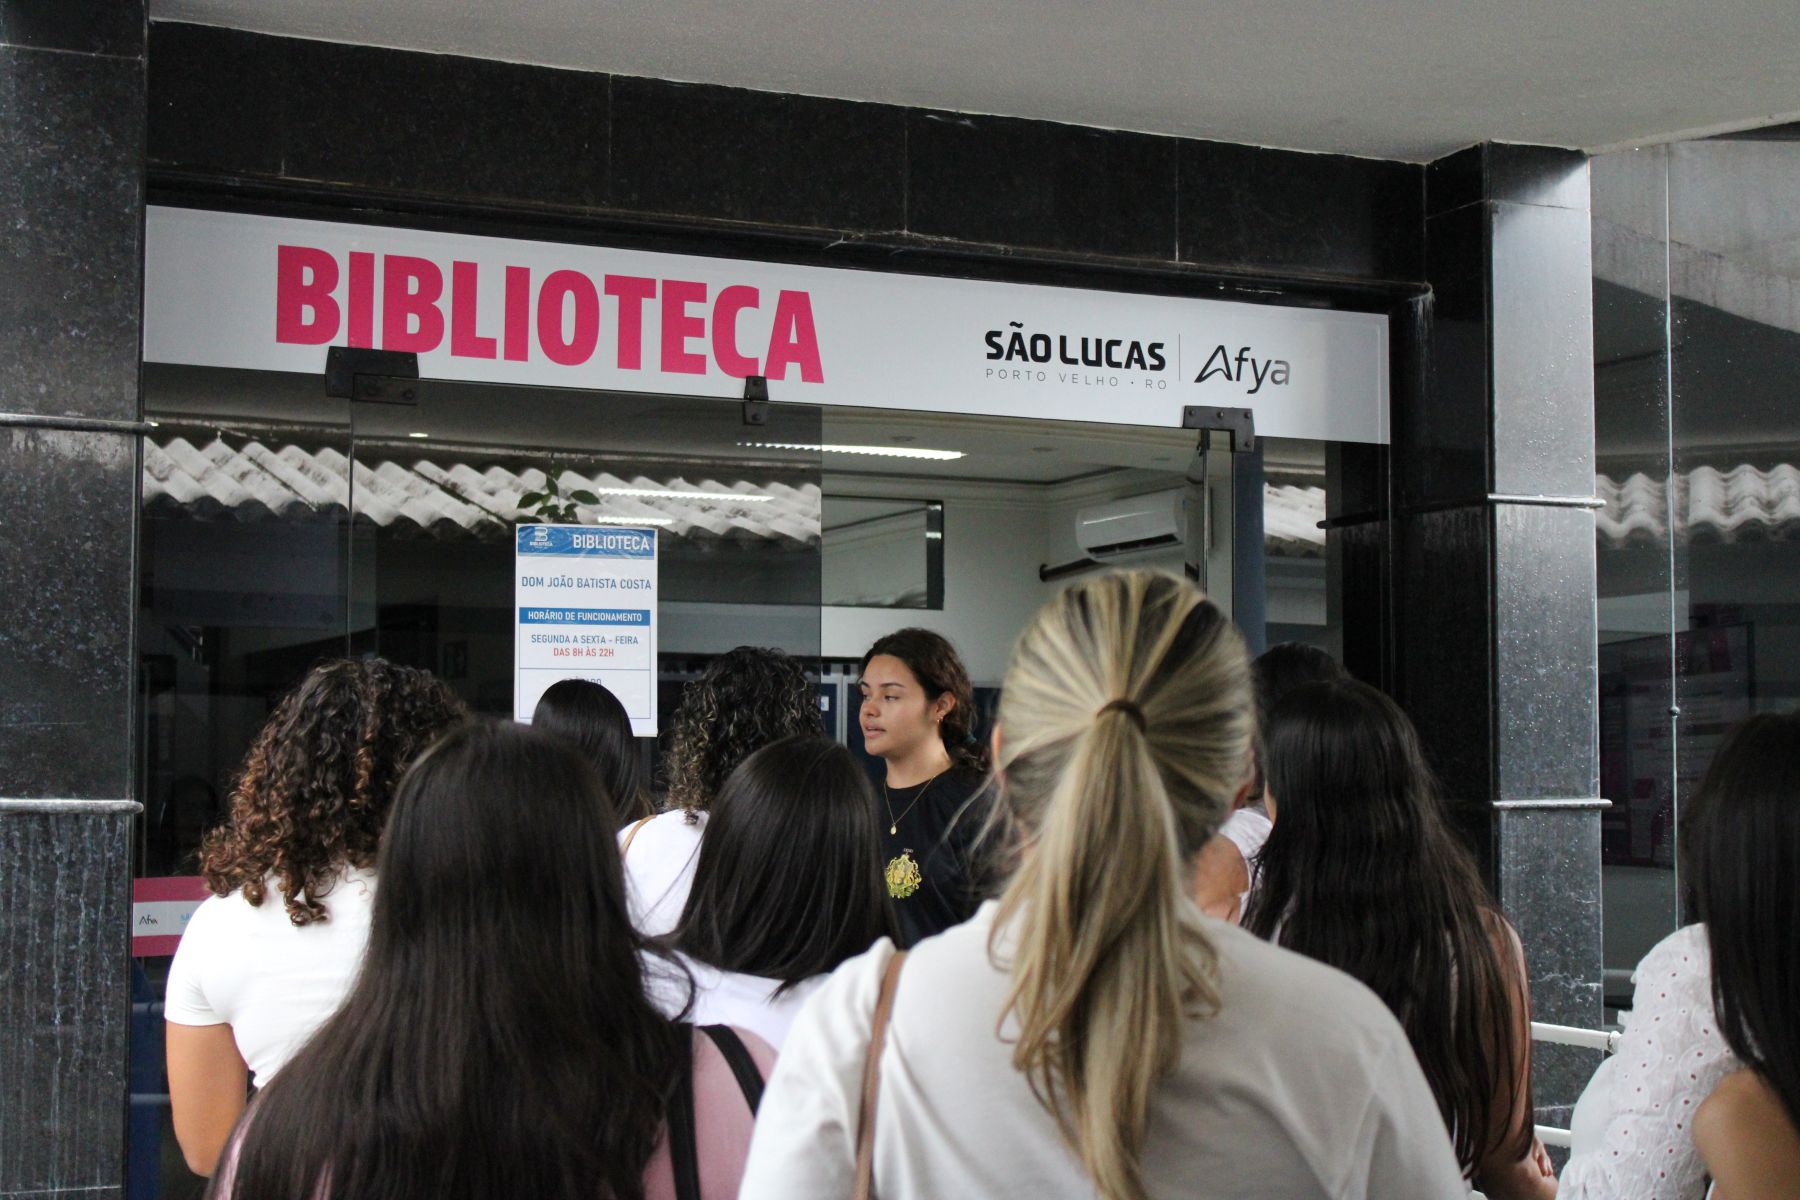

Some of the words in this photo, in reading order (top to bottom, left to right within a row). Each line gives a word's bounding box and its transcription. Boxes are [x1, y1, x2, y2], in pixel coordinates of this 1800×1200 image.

[276, 245, 825, 384] BIBLIOTECA
[985, 321, 1052, 363] SÃO
[1059, 335, 1166, 371] LUCAS
[1194, 344, 1290, 394] Afya
[986, 368, 1046, 382] PORTO
[1059, 373, 1119, 387] VELHO
[1146, 379, 1167, 390] RO
[573, 534, 650, 550] BIBLIOTECA
[521, 576, 544, 587] DOM
[547, 575, 574, 588] JOÃO
[577, 578, 617, 589] BATISTA
[620, 579, 652, 589] COSTA
[528, 609, 563, 620] HORÁRIO
[565, 611, 576, 620] DE
[577, 612, 642, 622] FUNCIONAMENTO
[531, 634, 570, 643] SEGUNDA
[572, 635, 579, 644] A
[580, 635, 606, 644] SEXTA
[615, 635, 639, 645] FEIRA
[553, 648, 570, 657] DAS
[572, 648, 583, 656] 8H
[585, 646, 597, 657] ÀS
[599, 648, 614, 657] 22H
